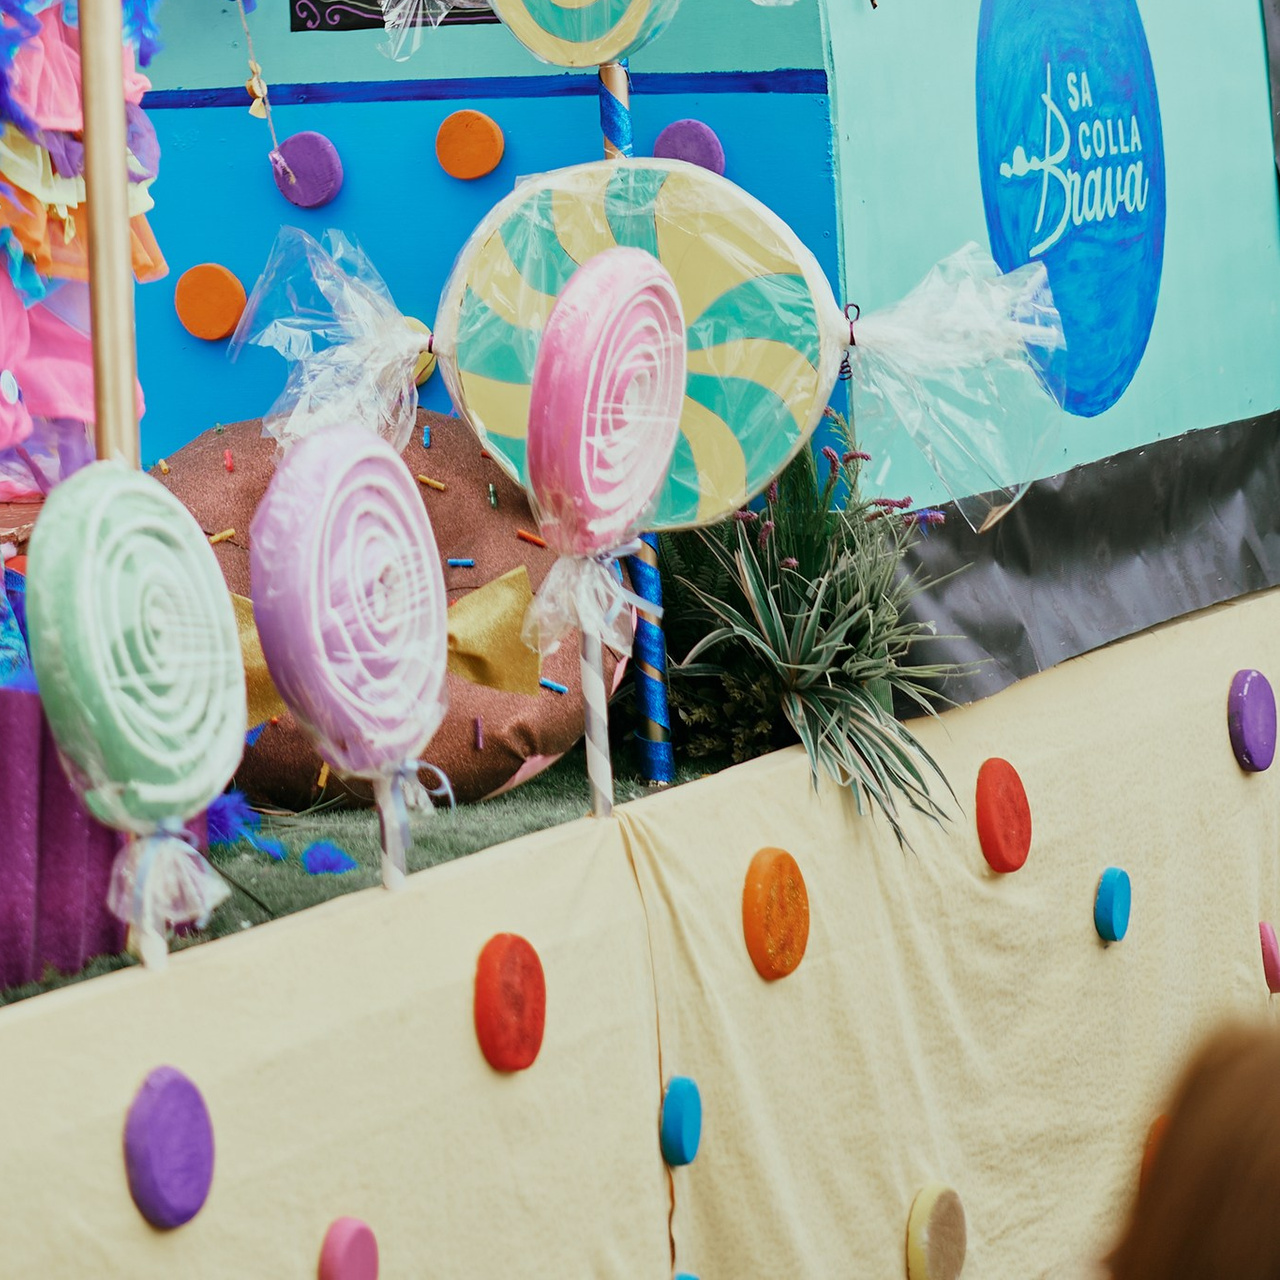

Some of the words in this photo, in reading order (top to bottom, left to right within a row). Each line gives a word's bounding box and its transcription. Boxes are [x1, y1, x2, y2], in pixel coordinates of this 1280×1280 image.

[1066, 71, 1093, 112] SA
[1025, 62, 1149, 258] Brava
[1078, 115, 1143, 161] COLLA
